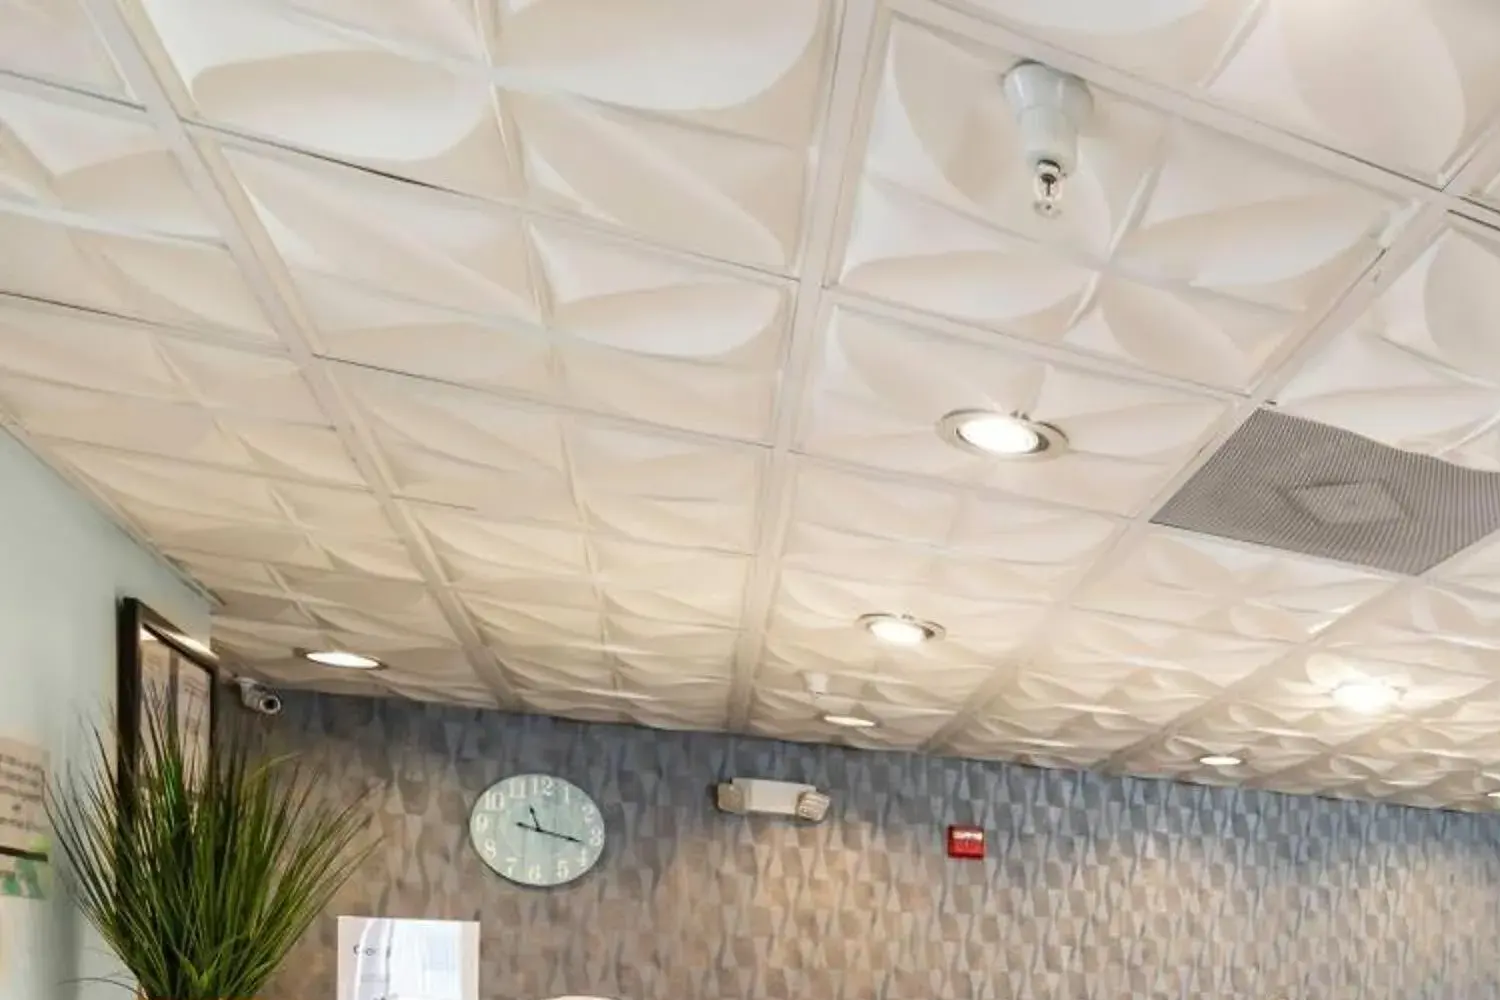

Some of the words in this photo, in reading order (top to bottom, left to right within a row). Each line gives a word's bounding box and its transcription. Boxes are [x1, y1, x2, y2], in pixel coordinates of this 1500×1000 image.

[509, 780, 526, 799] 11
[533, 776, 553, 797] 12
[564, 784, 570, 804] 1
[485, 789, 505, 810] 10
[476, 813, 488, 833] 9
[582, 804, 595, 823] 2
[590, 827, 602, 847] 3
[485, 838, 497, 860] 8
[506, 857, 518, 877] 7
[528, 863, 541, 881] 6
[556, 860, 569, 880] 5
